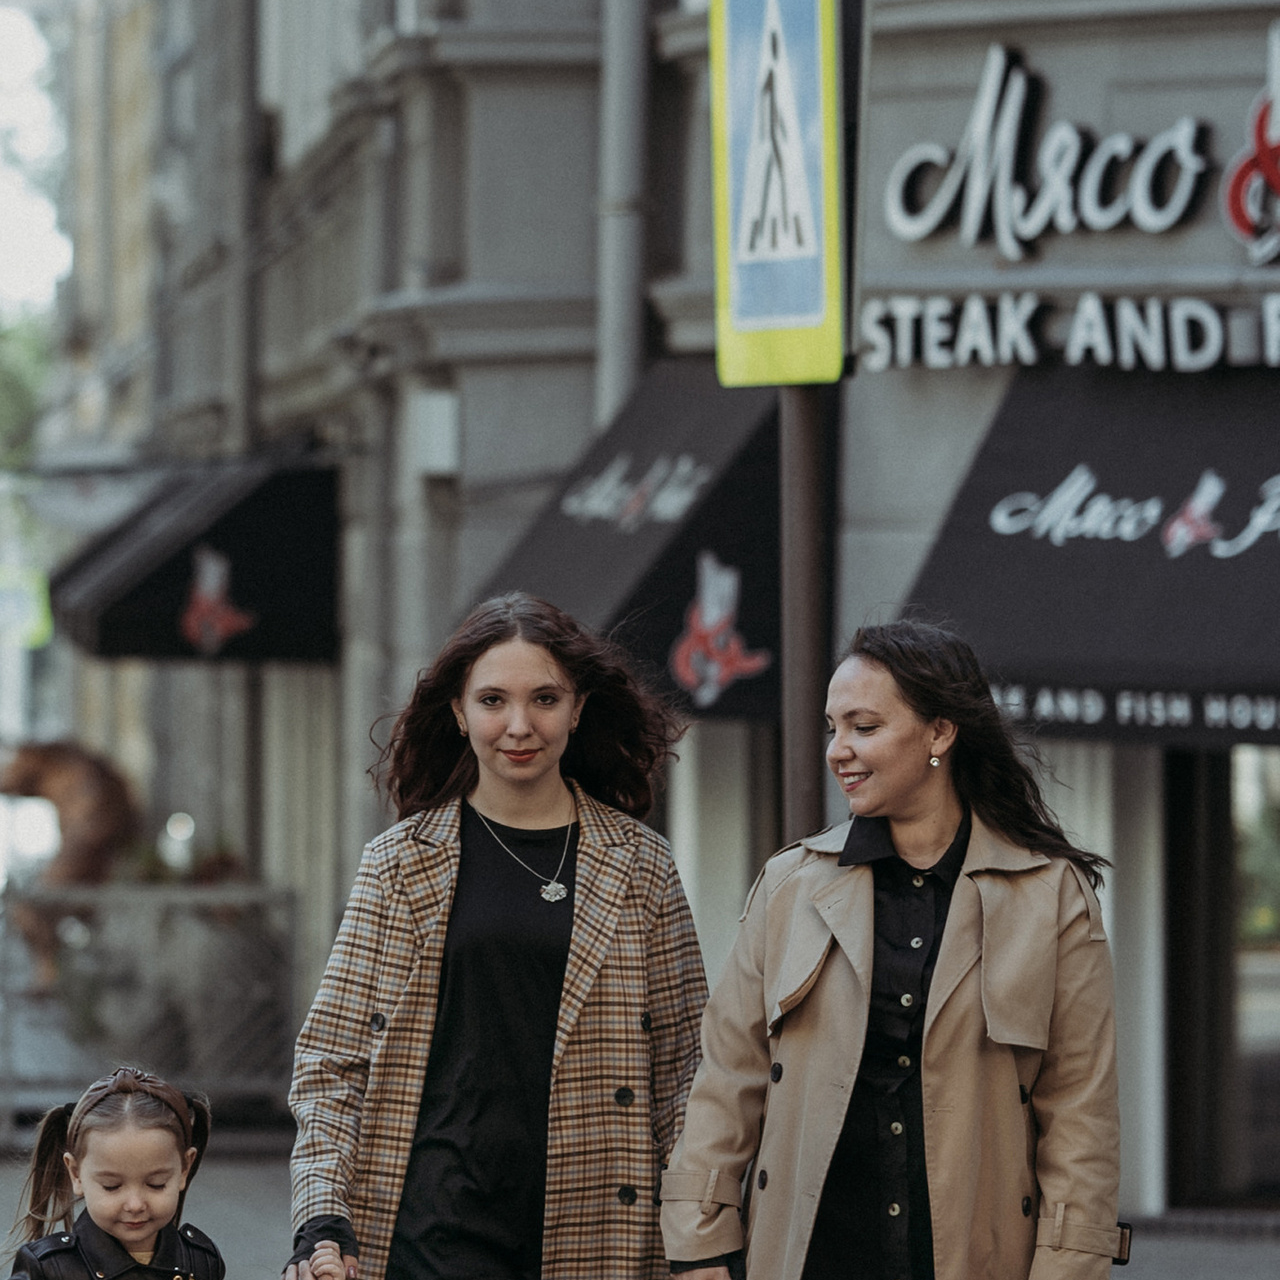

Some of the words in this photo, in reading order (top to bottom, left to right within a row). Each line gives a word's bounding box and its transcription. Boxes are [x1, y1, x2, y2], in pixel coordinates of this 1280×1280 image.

[884, 45, 1202, 260] Мясо
[860, 294, 1036, 372] STEAK
[1065, 293, 1223, 372] AND
[1116, 690, 1193, 726] FISH
[1204, 694, 1280, 730] HOU
